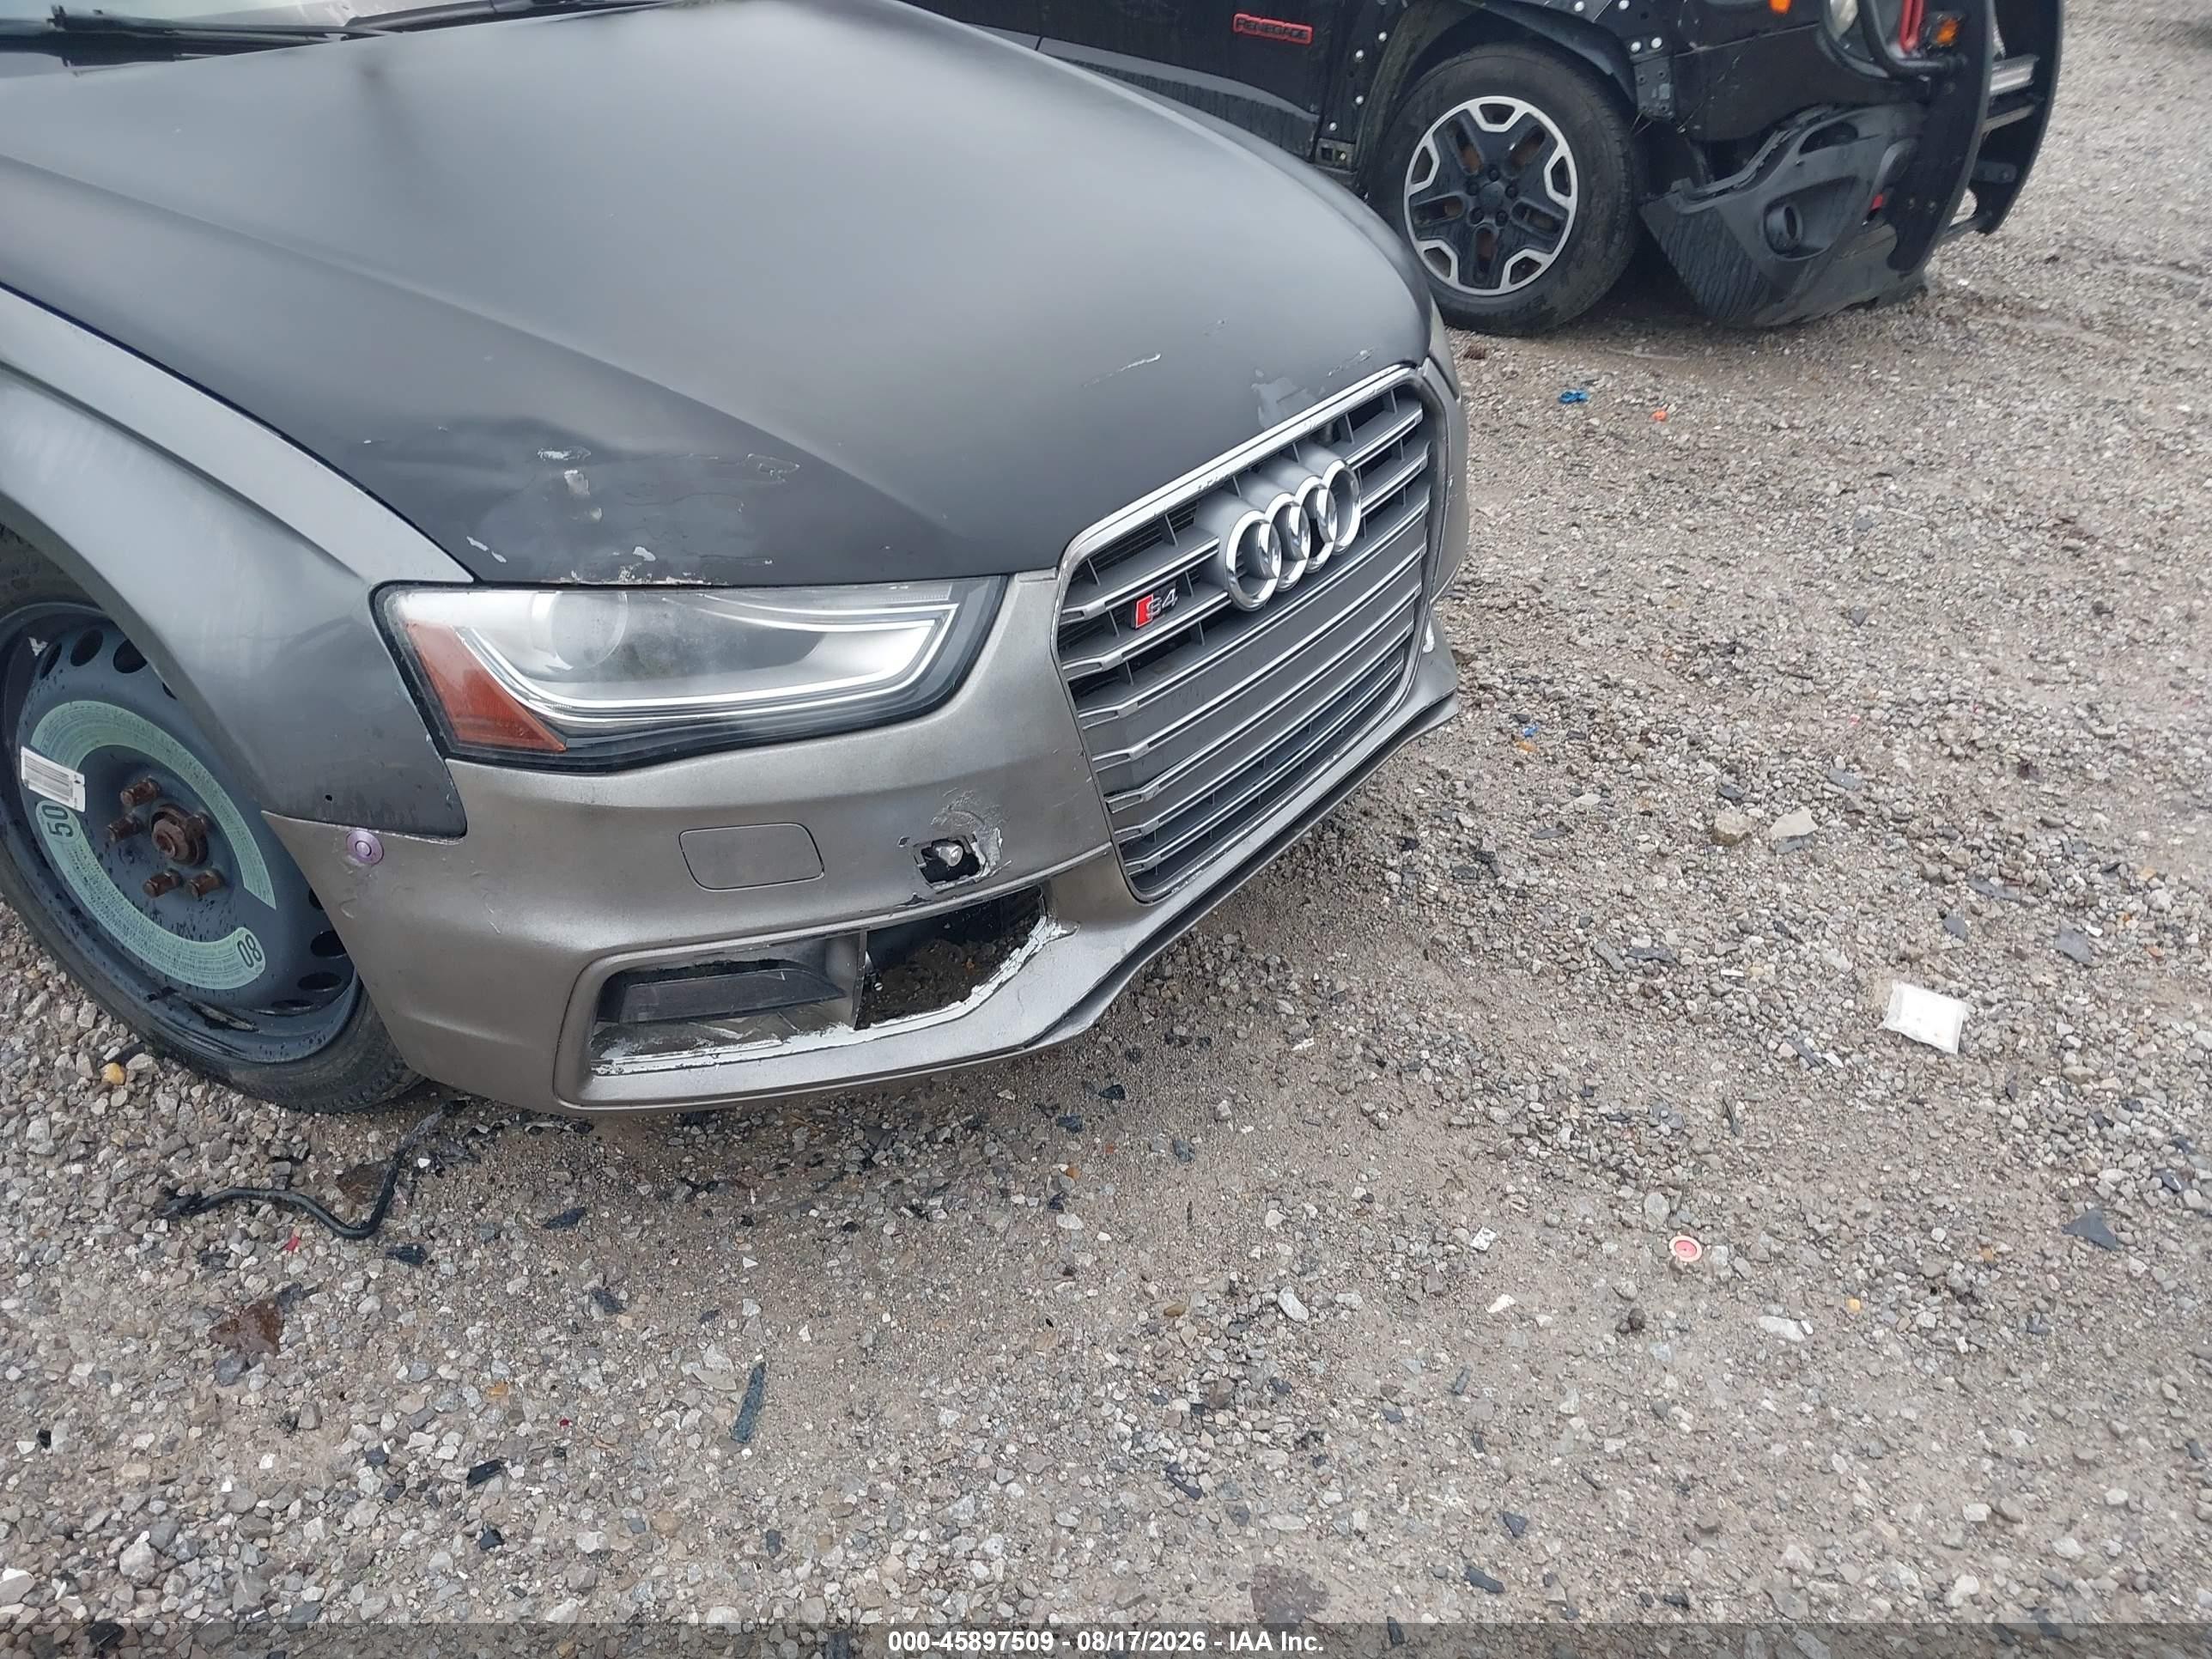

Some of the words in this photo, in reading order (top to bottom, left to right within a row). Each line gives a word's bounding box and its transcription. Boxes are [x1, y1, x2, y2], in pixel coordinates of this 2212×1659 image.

[1235, 15, 1310, 42] RENEGADE
[1146, 588, 1178, 618] S4
[41, 805, 74, 837] 50
[237, 934, 262, 968] 80
